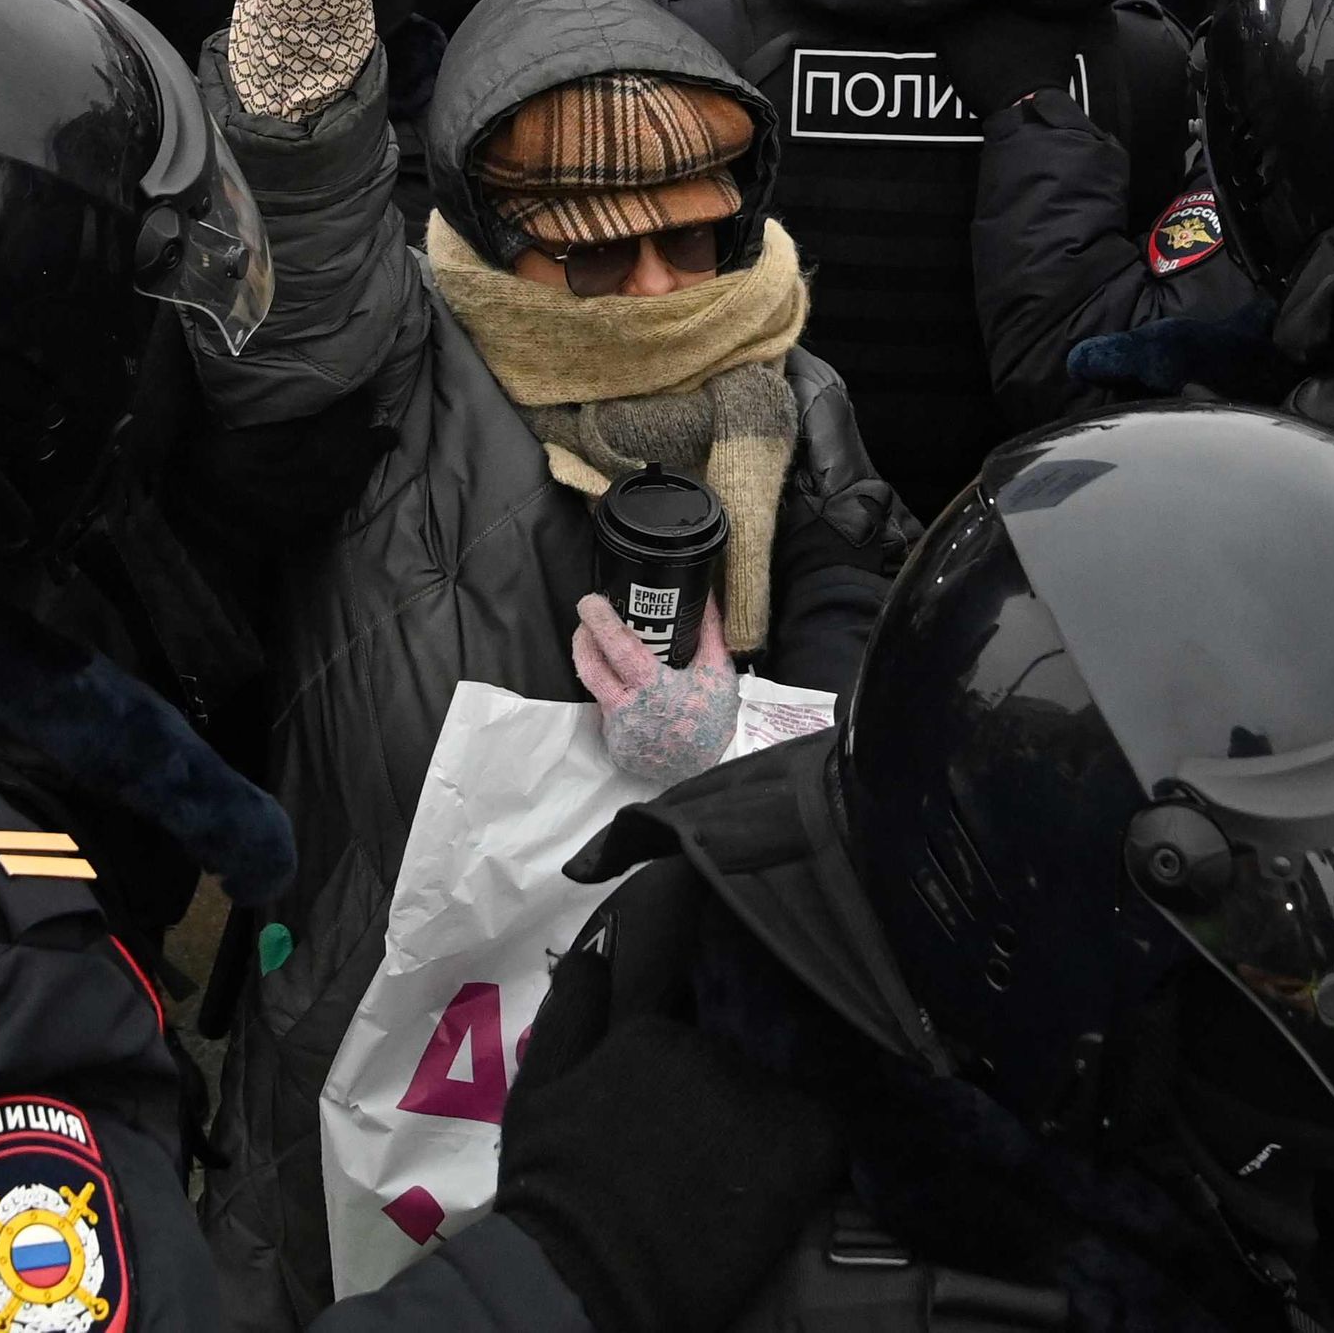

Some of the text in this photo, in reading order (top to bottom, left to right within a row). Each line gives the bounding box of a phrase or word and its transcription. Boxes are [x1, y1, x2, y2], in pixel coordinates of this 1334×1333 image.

[805, 71, 1077, 119] ПОЛИ
[642, 591, 676, 604] PRICE
[634, 601, 673, 616] COFFEE
